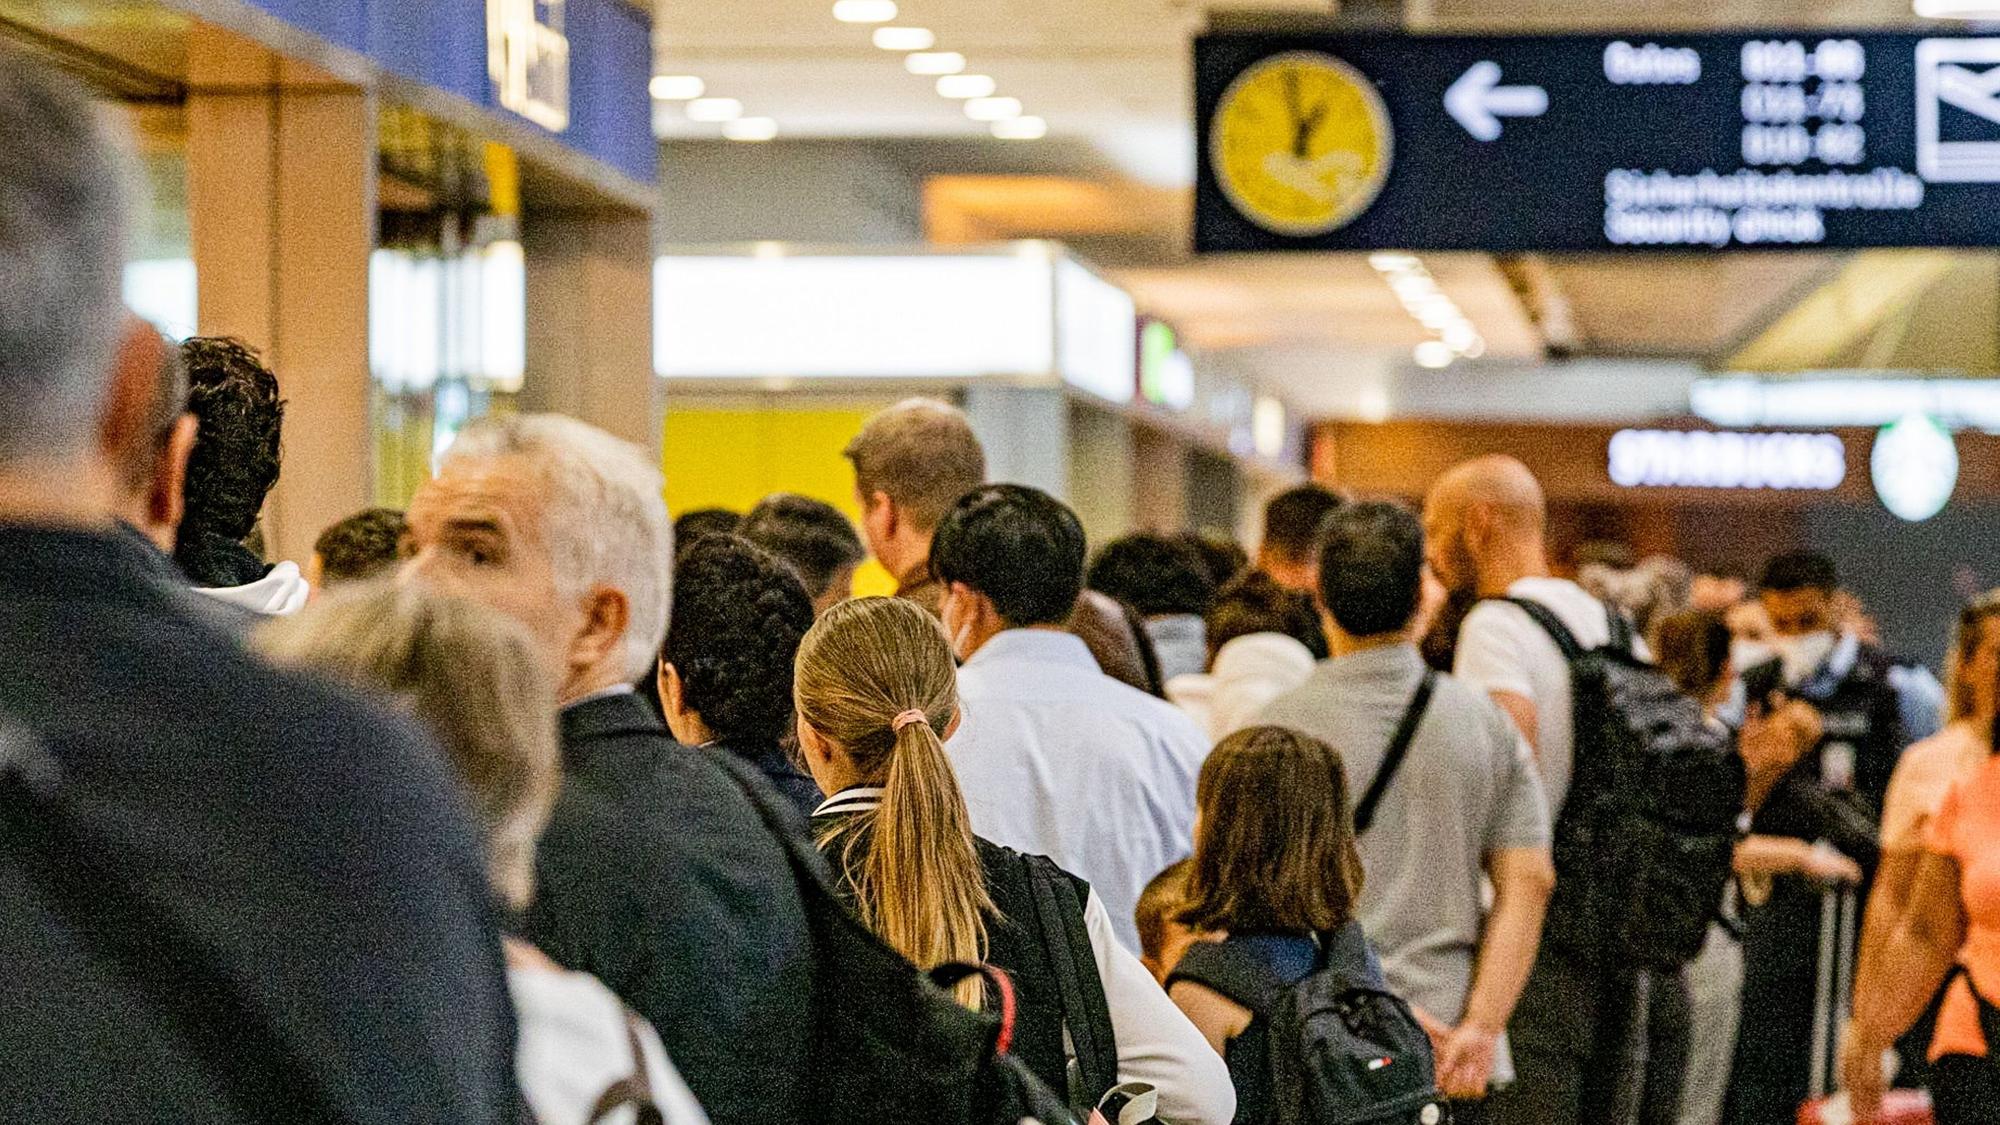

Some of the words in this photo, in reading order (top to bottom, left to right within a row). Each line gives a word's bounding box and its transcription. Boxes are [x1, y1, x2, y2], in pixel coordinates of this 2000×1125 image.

[1604, 40, 1700, 84] Gates
[1604, 168, 1923, 208] Sicherheitskontrolle
[1604, 205, 1730, 247] Security
[1609, 429, 1845, 489] STARBUCKS
